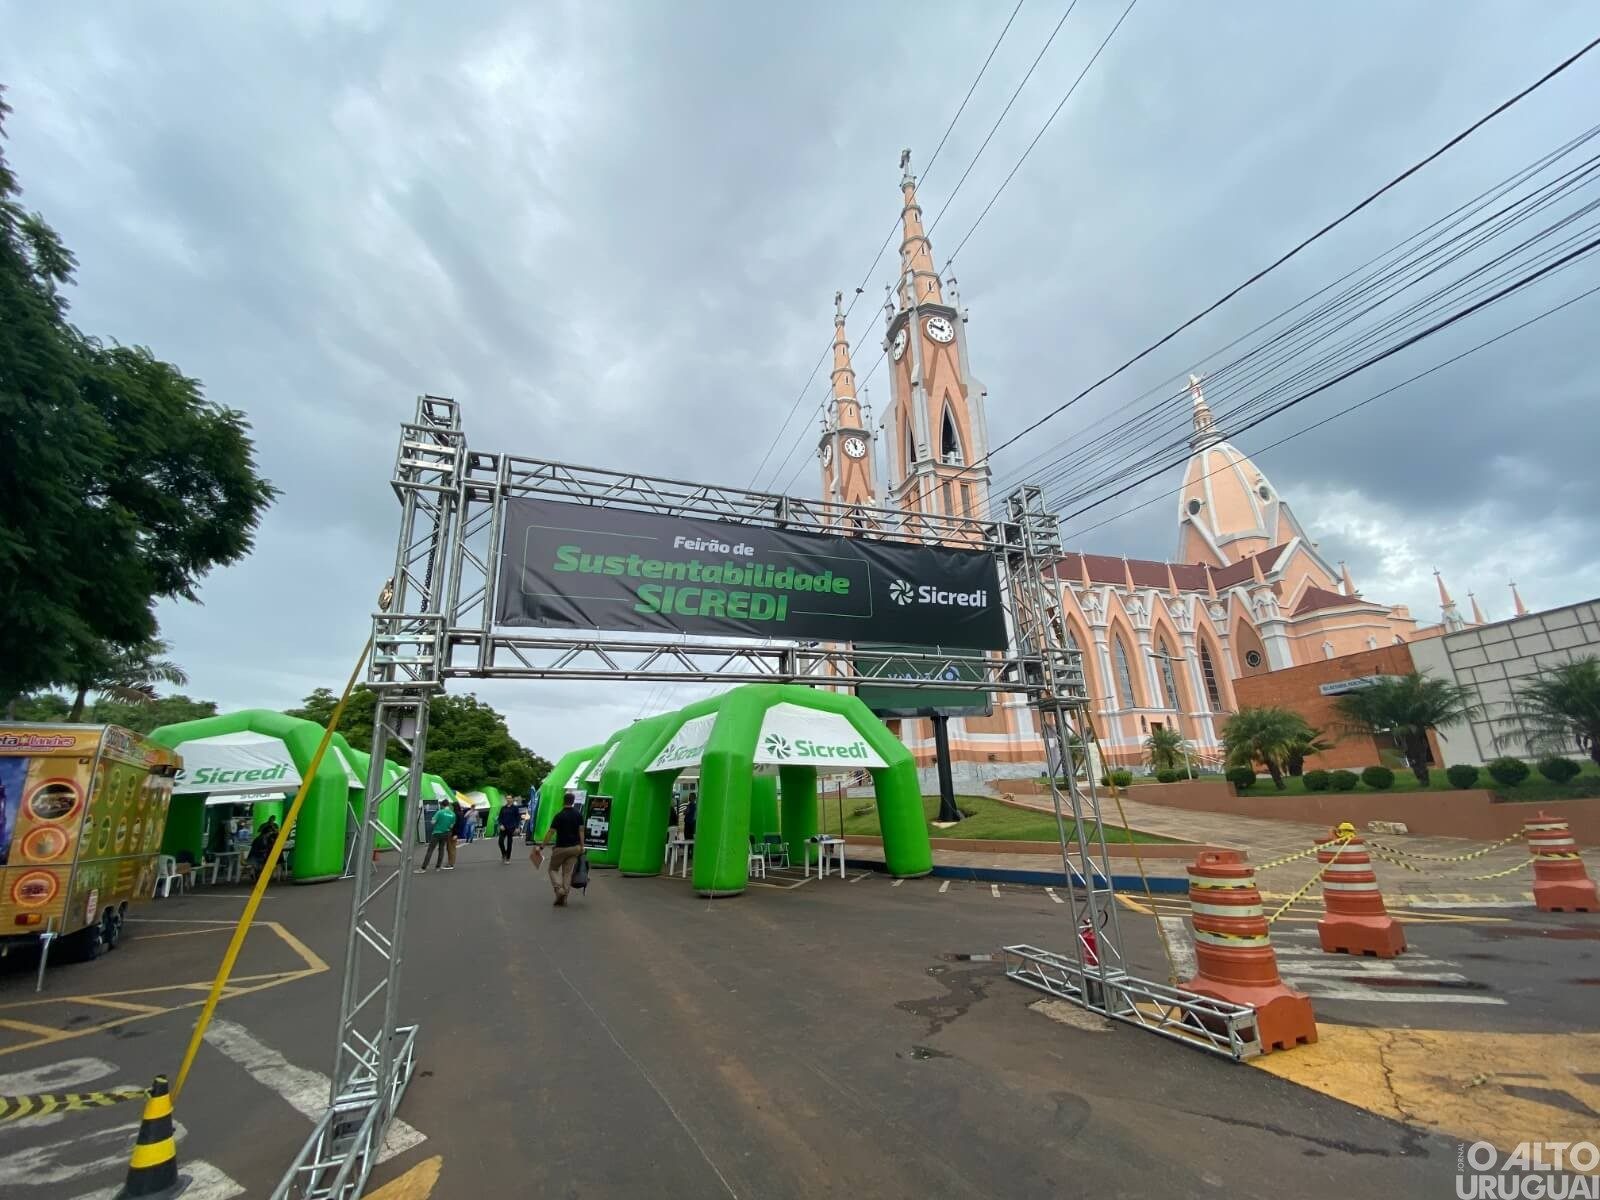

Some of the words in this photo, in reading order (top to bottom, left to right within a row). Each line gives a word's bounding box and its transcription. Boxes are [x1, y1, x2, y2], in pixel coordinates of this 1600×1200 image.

[673, 536, 730, 553] Feirão
[733, 543, 754, 556] de
[553, 545, 850, 594] Sustentabilidade
[633, 584, 788, 621] SICREDI
[918, 586, 987, 607] Sicredi
[794, 740, 868, 759] Sicredi
[191, 763, 289, 785] Sicredi
